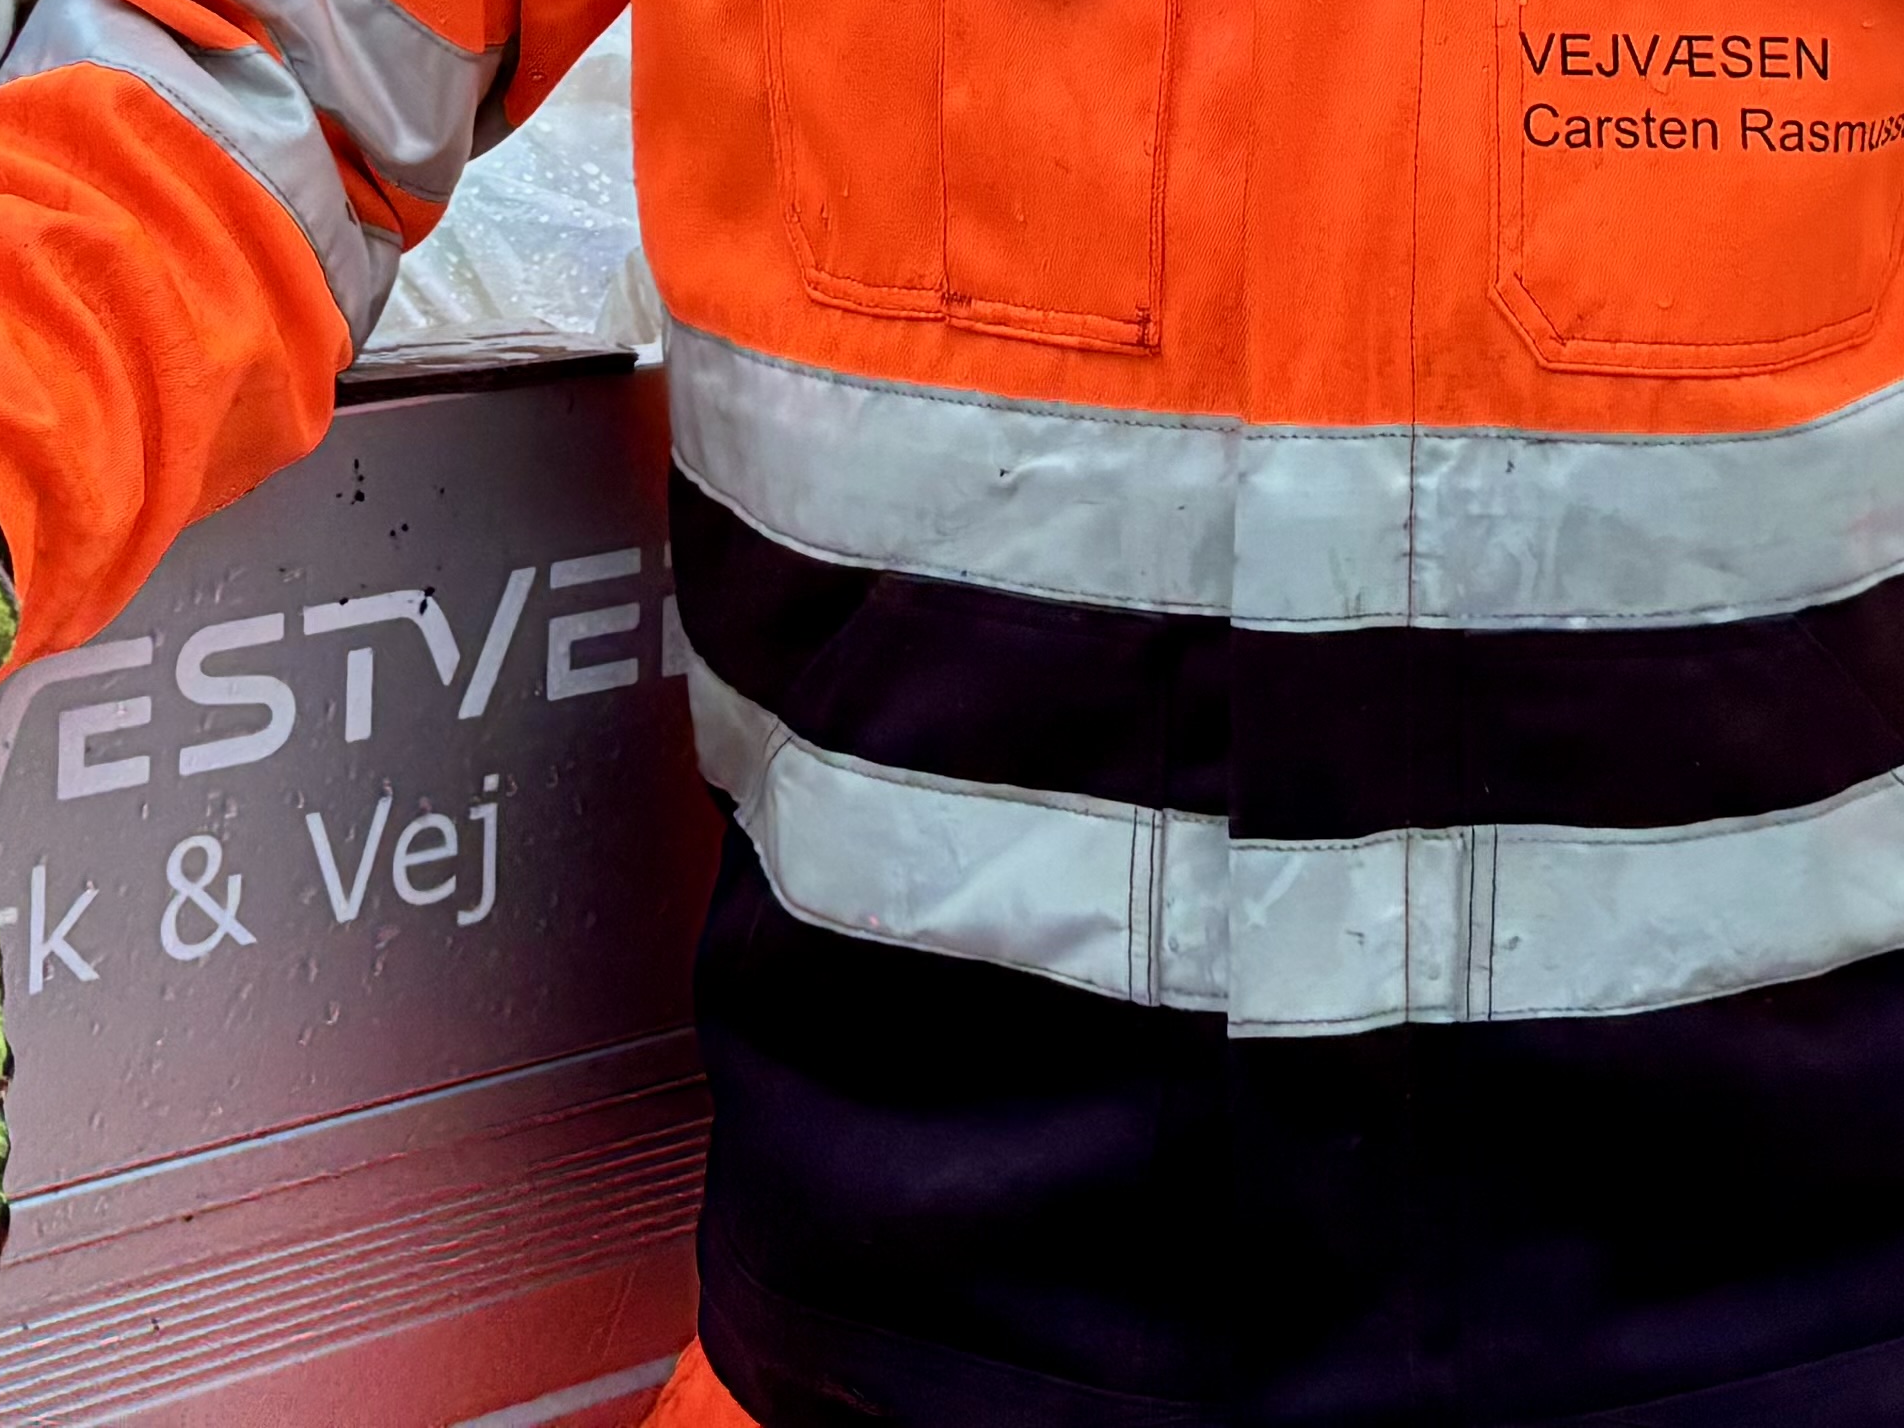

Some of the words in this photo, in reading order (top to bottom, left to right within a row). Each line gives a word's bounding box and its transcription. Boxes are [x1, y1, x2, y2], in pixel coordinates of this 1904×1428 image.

[1519, 32, 1830, 82] VEJVÆSEN
[1523, 102, 1719, 151] Carsten
[160, 833, 259, 963] &
[303, 773, 505, 928] Vej
